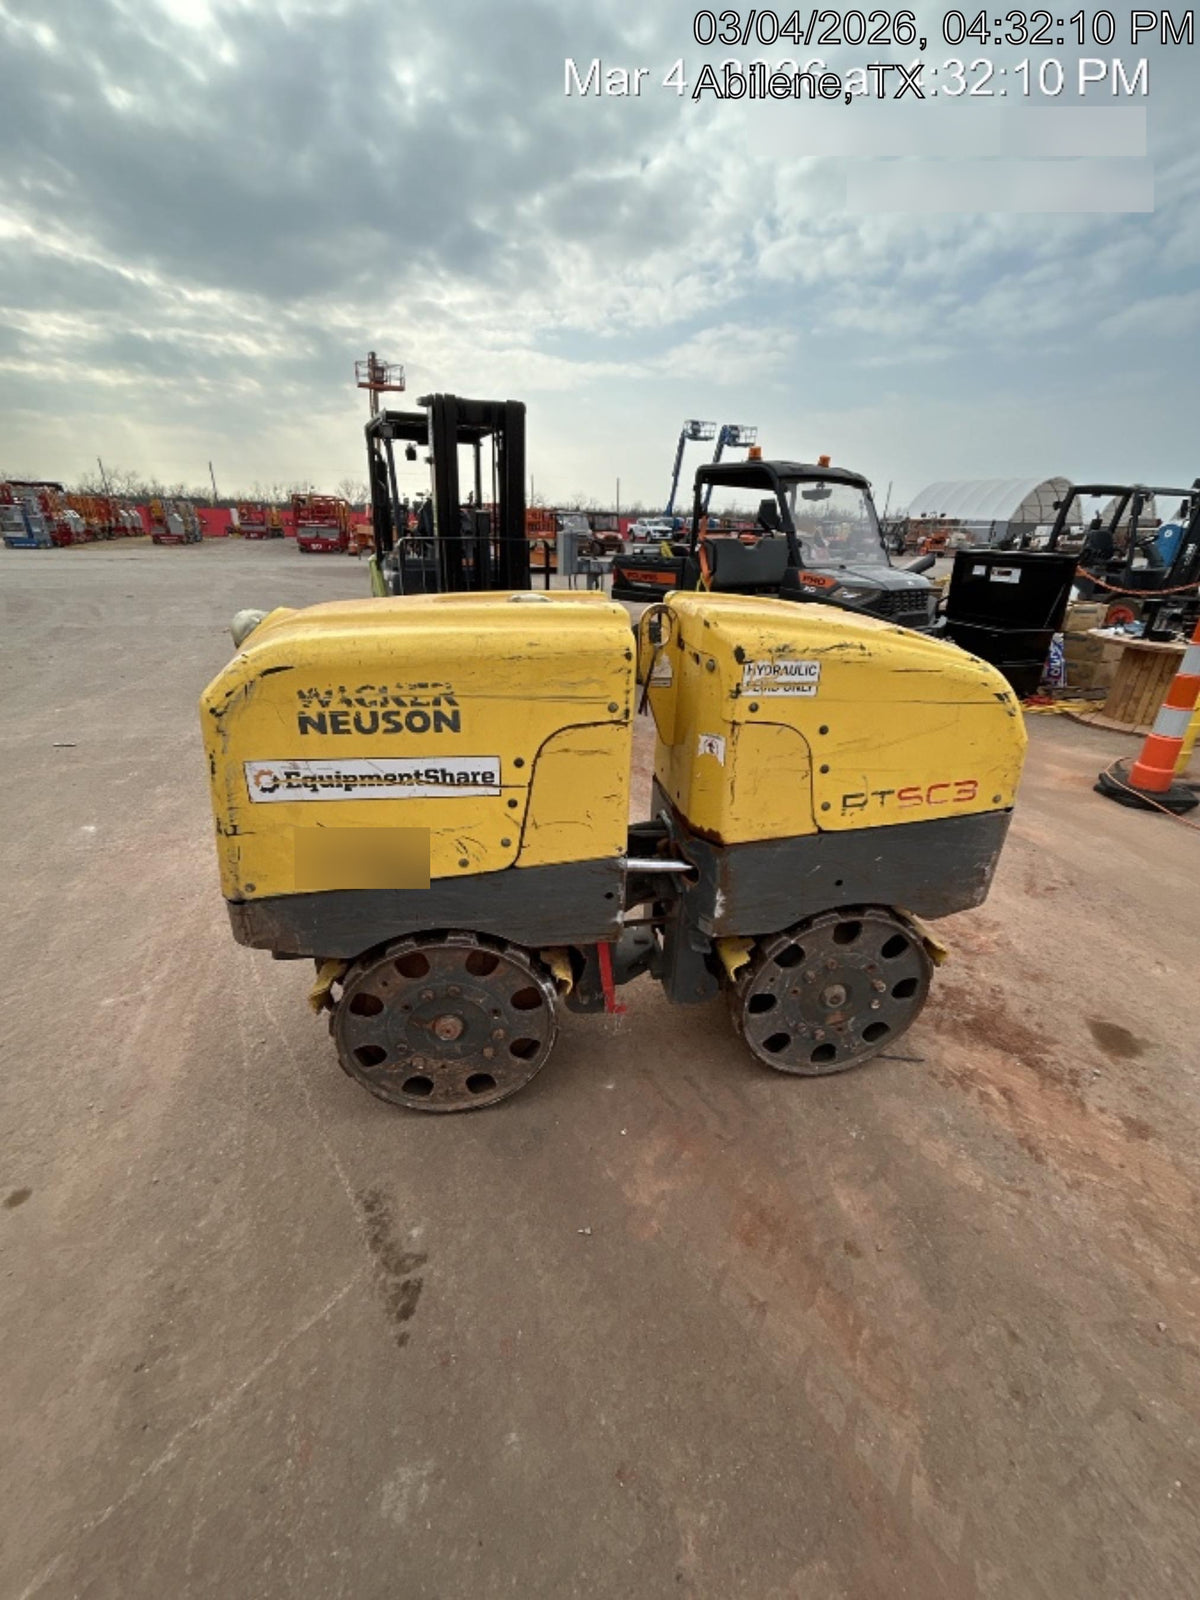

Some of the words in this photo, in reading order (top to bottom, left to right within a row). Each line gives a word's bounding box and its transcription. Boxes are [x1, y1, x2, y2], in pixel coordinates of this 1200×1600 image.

[747, 663, 817, 677] HYDRAULIC
[298, 709, 461, 735] NEUSON
[283, 767, 496, 792] EquipmentShare
